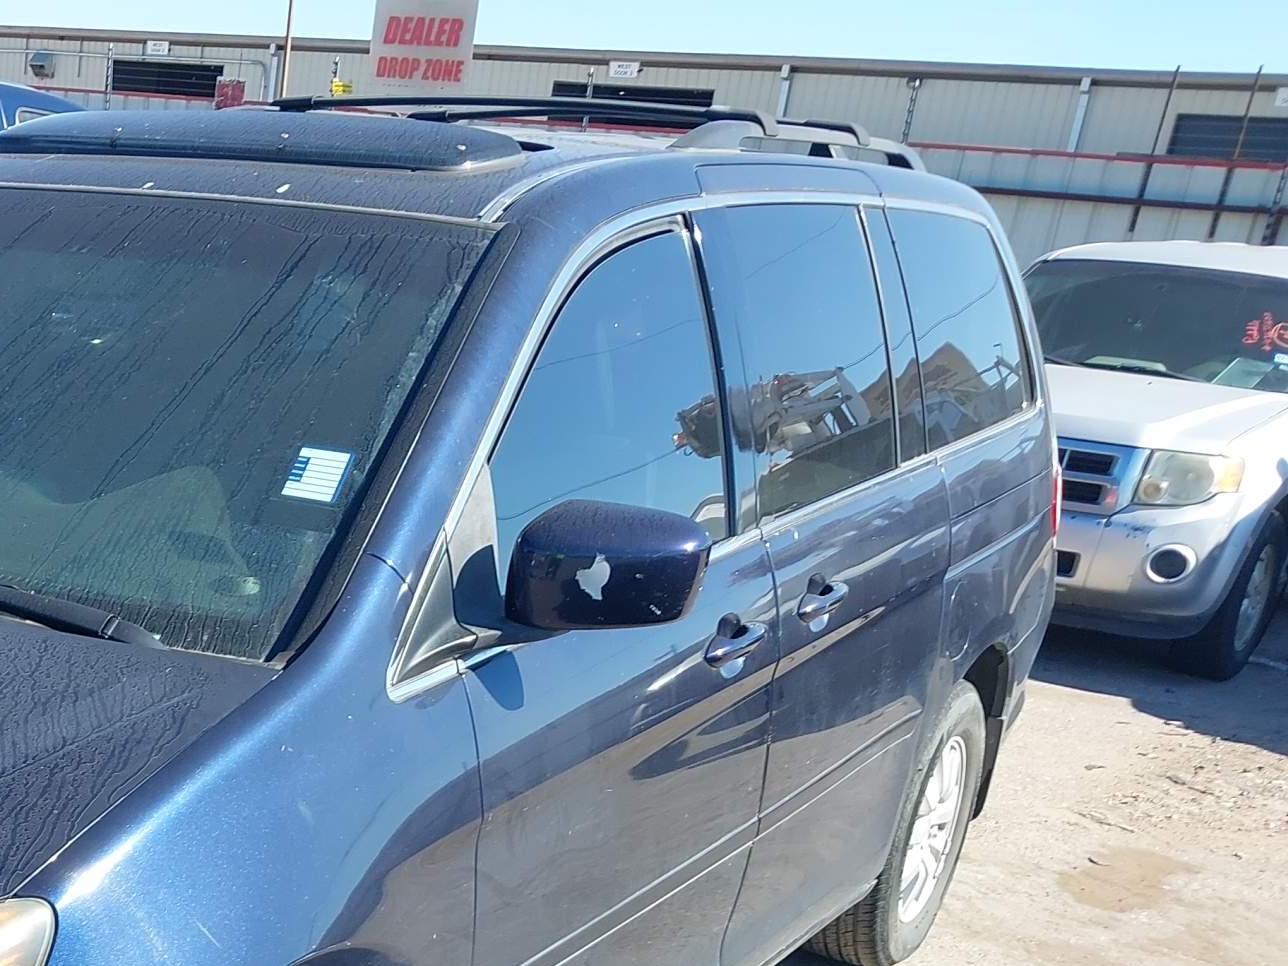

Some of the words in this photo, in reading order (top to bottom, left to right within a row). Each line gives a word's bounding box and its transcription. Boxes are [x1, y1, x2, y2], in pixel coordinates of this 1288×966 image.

[383, 16, 464, 47] DEALER
[376, 56, 421, 79] DROP
[421, 58, 464, 82] ZONE
